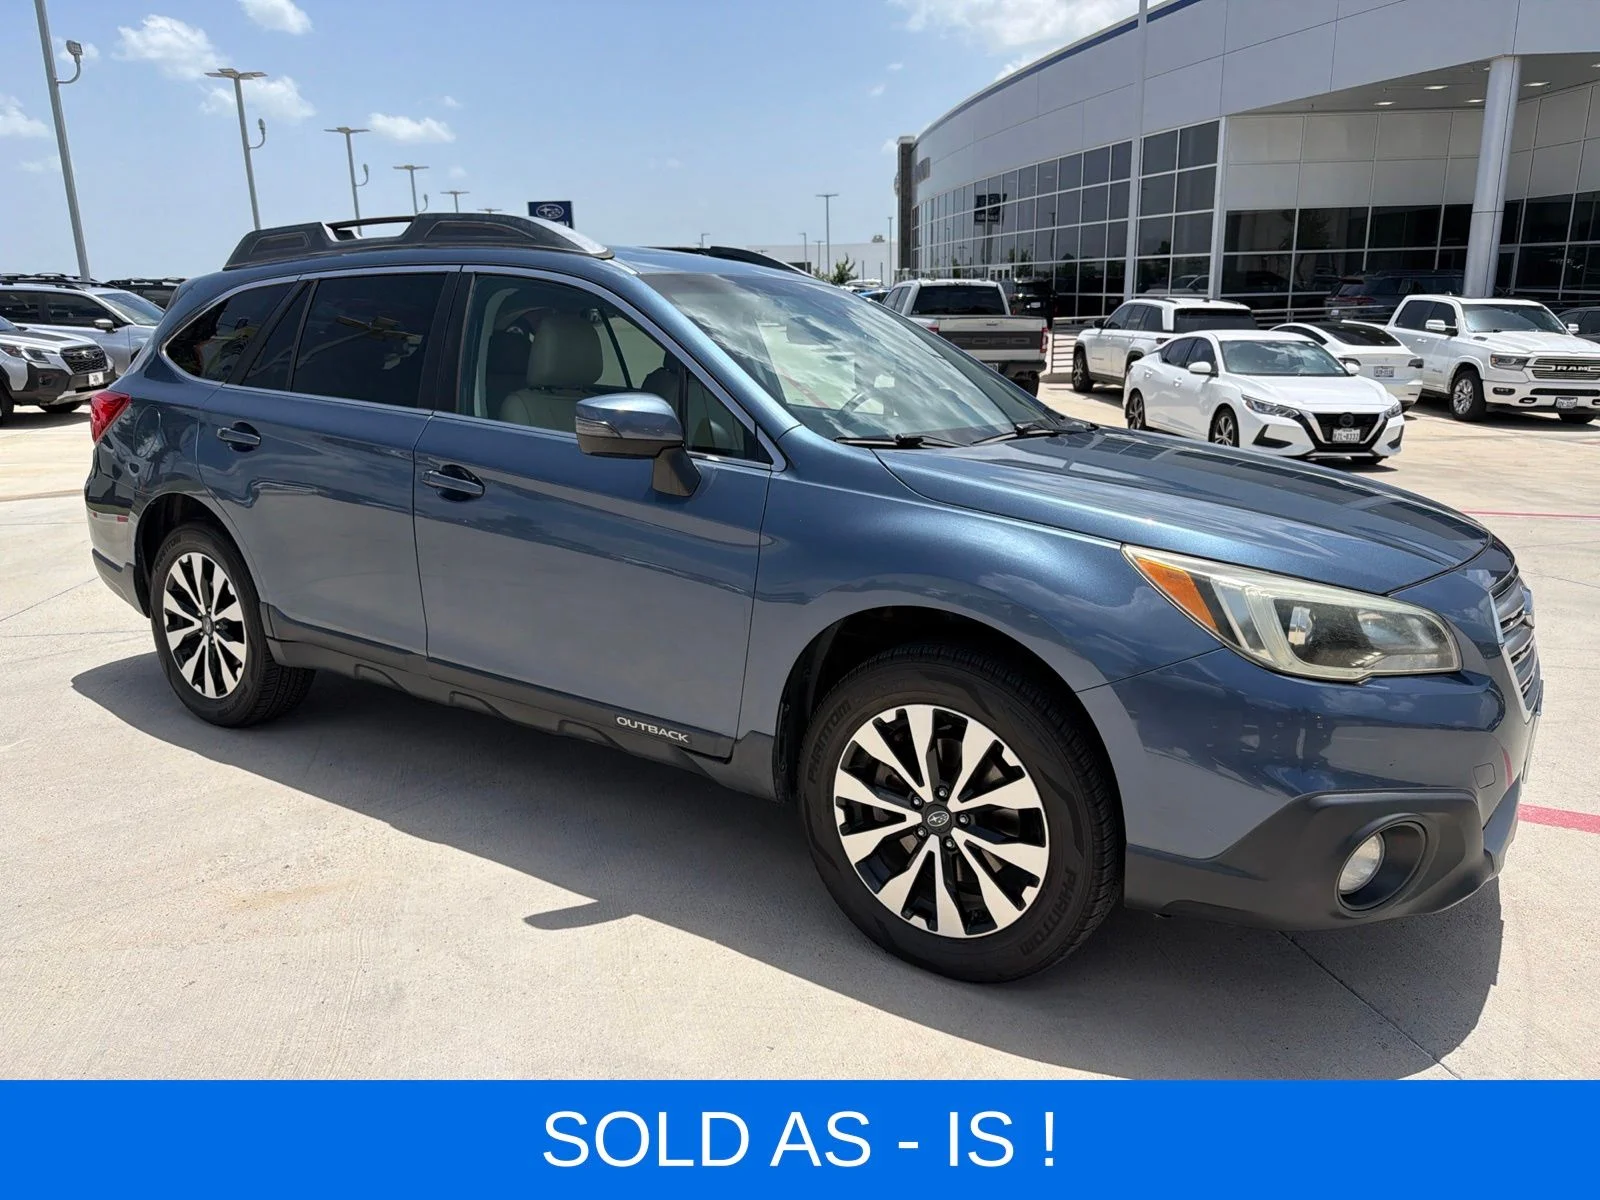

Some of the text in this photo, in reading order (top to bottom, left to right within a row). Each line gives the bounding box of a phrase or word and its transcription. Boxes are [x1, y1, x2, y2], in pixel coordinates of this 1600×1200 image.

[615, 715, 690, 743] OUTBACK
[807, 698, 852, 784] PHANTOM
[1018, 866, 1077, 956] PHANTOM
